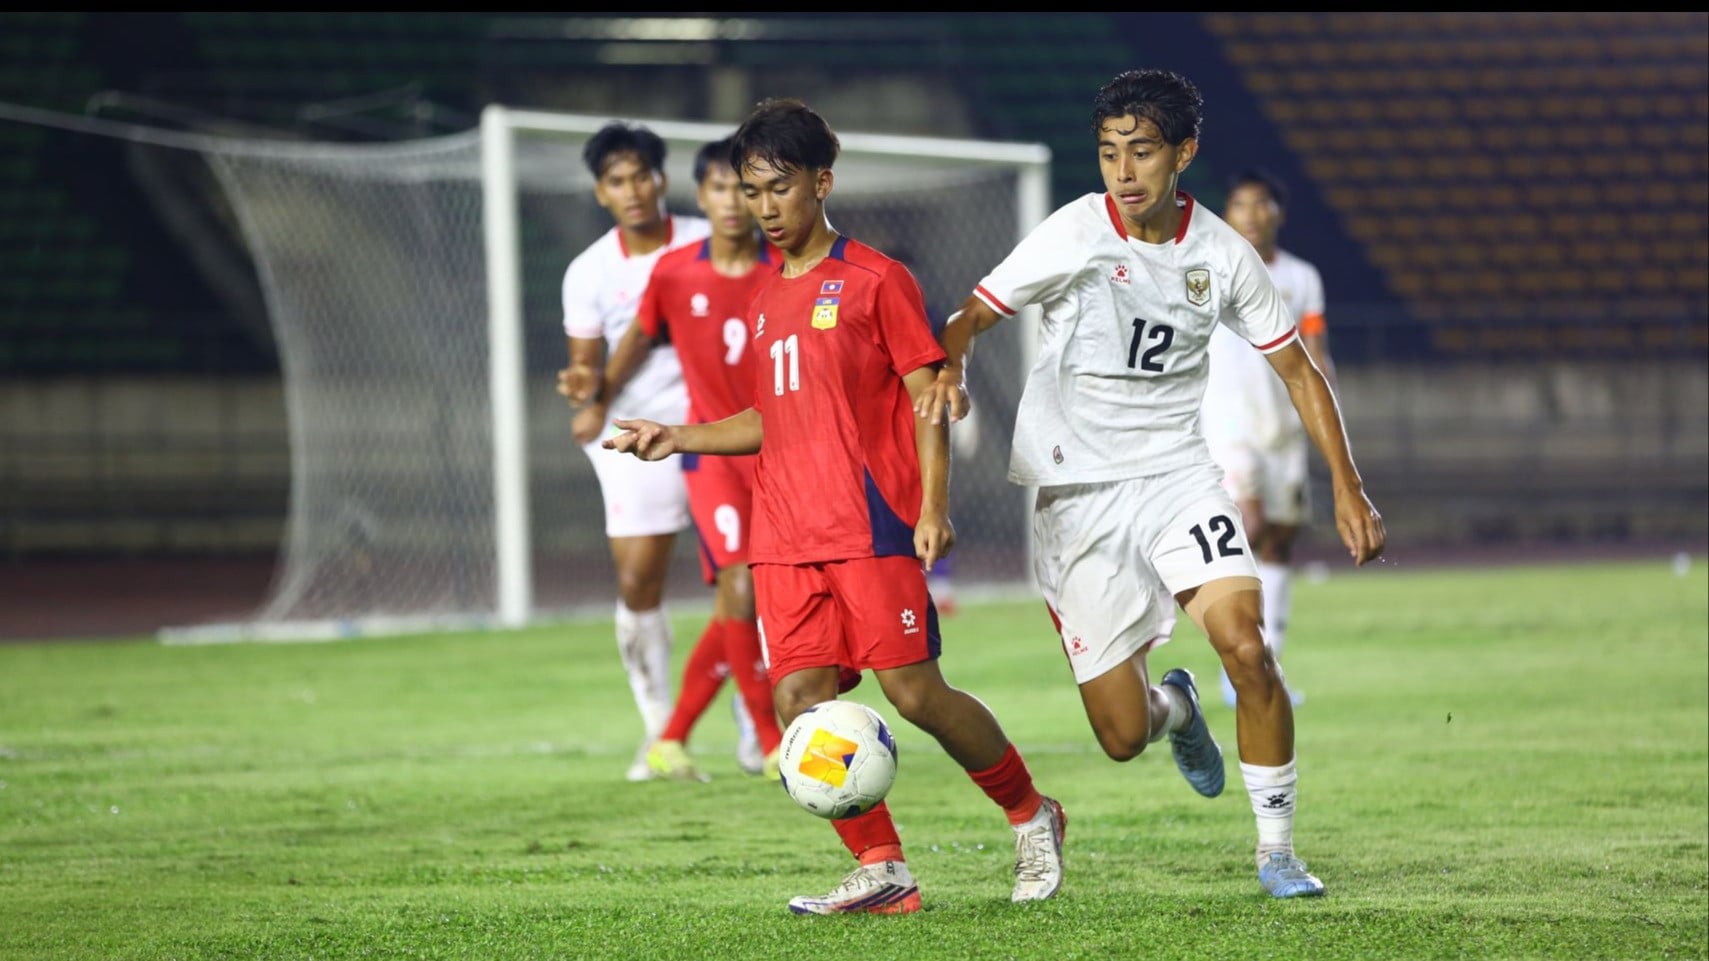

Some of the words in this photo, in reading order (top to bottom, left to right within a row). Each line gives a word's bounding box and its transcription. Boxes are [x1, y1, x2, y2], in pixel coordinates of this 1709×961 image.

[723, 317, 748, 365] 9
[769, 334, 800, 397] 11
[1127, 317, 1174, 372] 12
[714, 504, 740, 552] 9
[1188, 514, 1243, 564] 12
